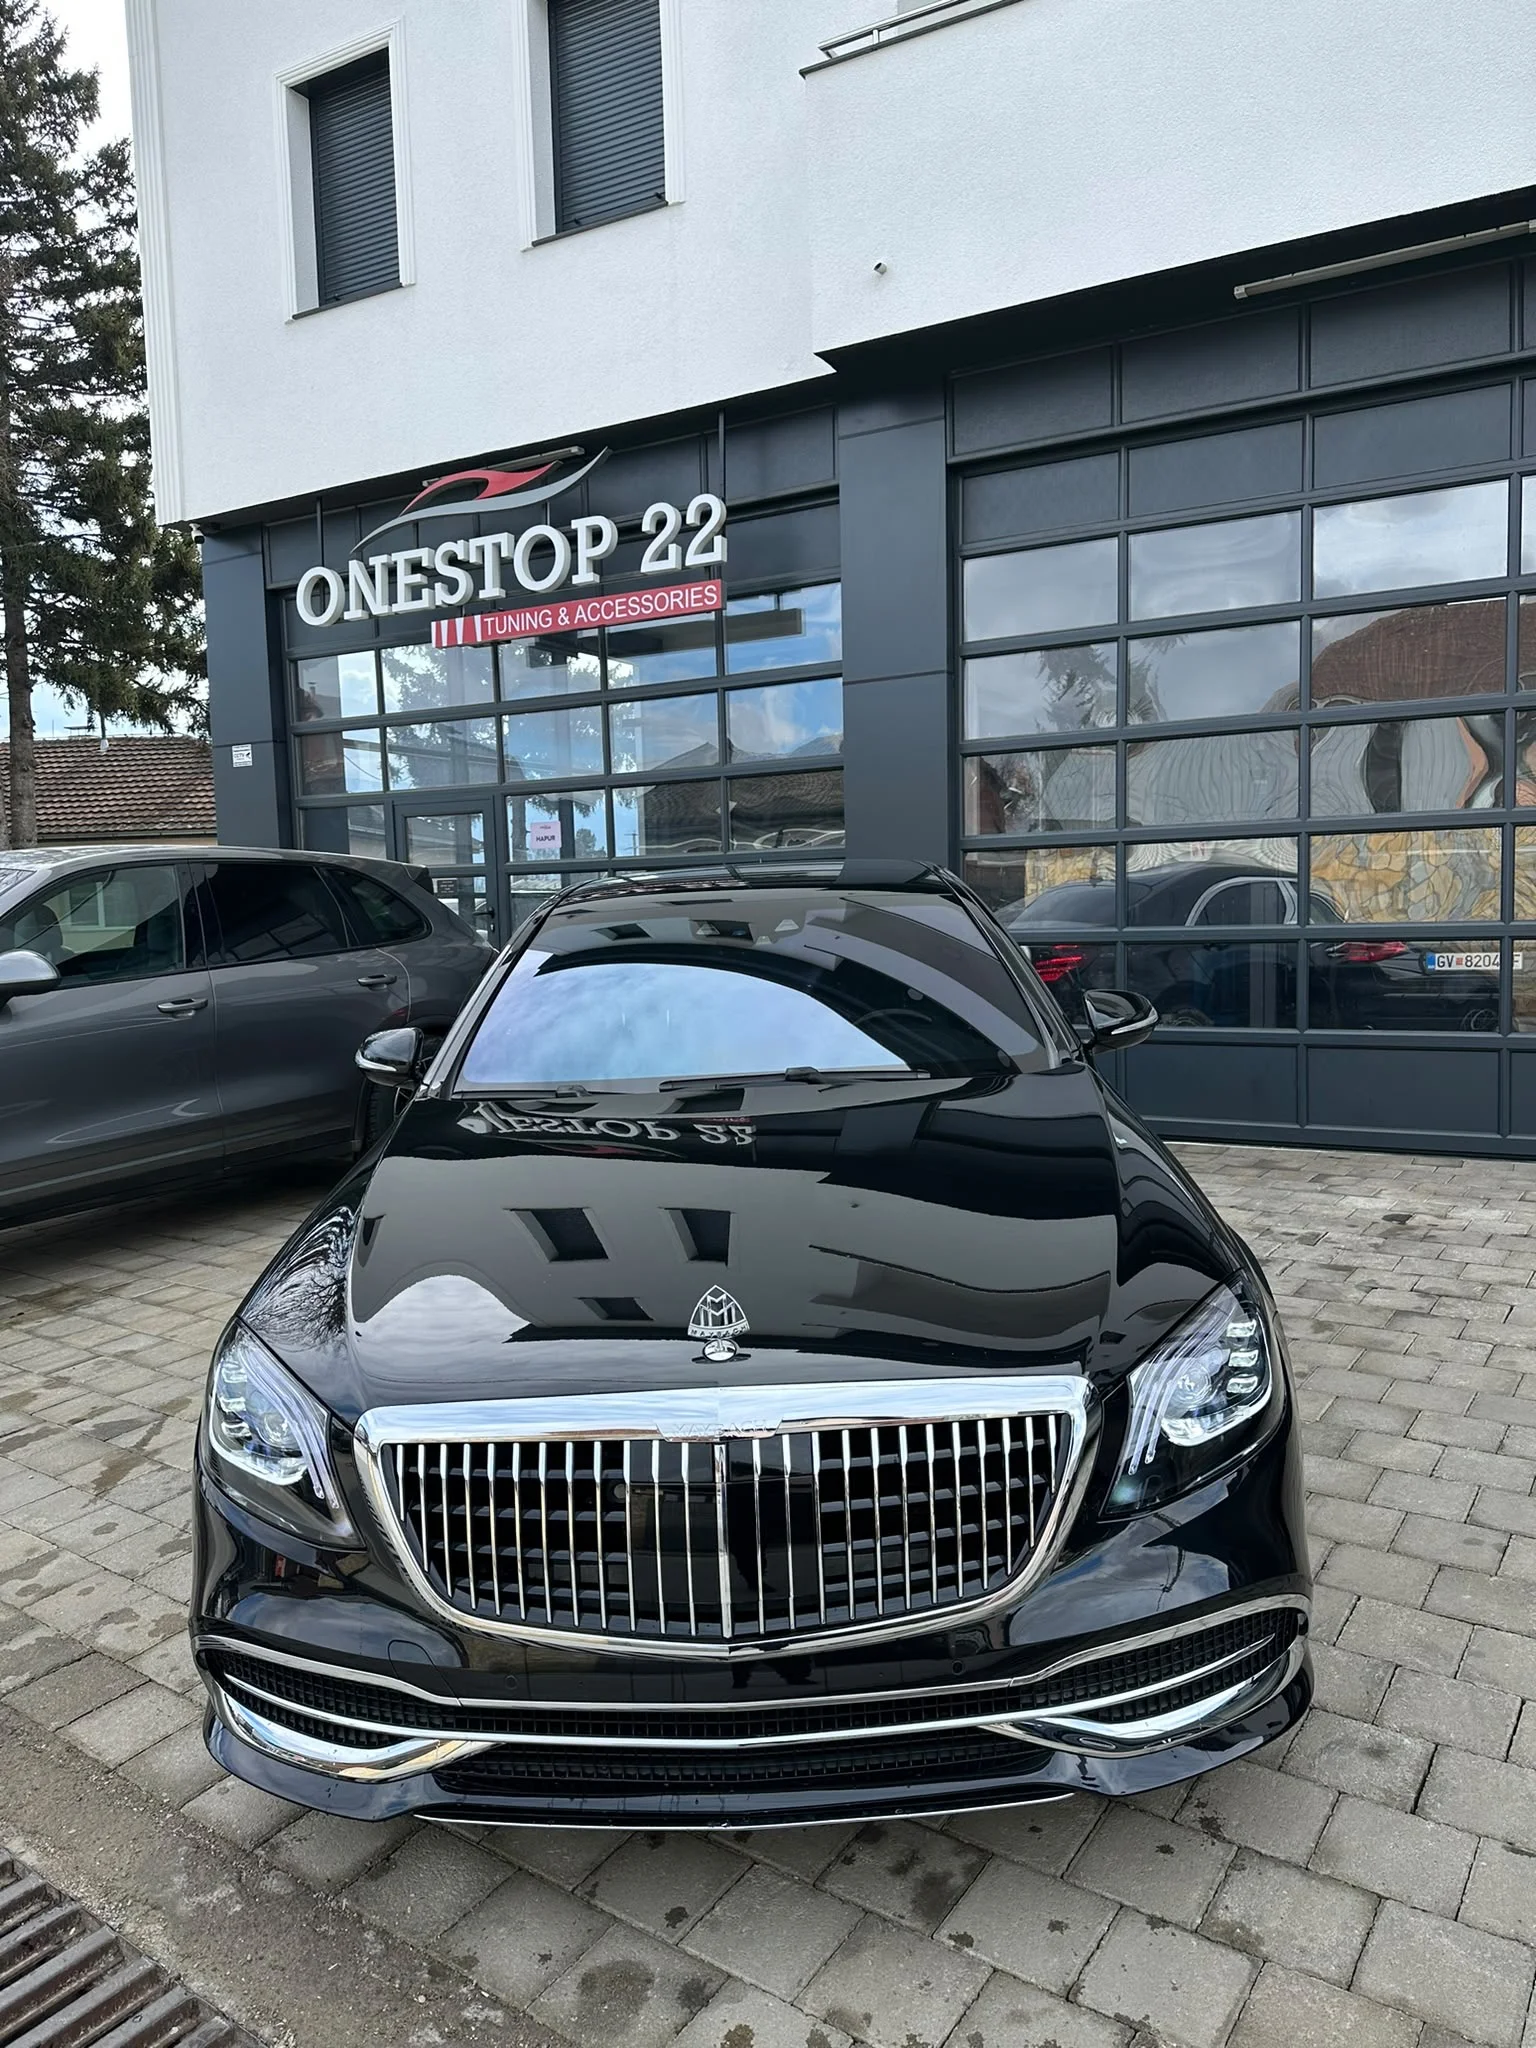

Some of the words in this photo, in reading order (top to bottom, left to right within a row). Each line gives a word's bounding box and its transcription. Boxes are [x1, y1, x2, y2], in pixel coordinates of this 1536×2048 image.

[296, 516, 618, 627] ONESTOP
[640, 493, 728, 574] 22
[484, 609, 551, 636] TUNING
[557, 607, 571, 625] &
[574, 584, 718, 623] ACCESSORIES
[1437, 954, 1454, 968] GV
[690, 1324, 746, 1337] MAYBACH
